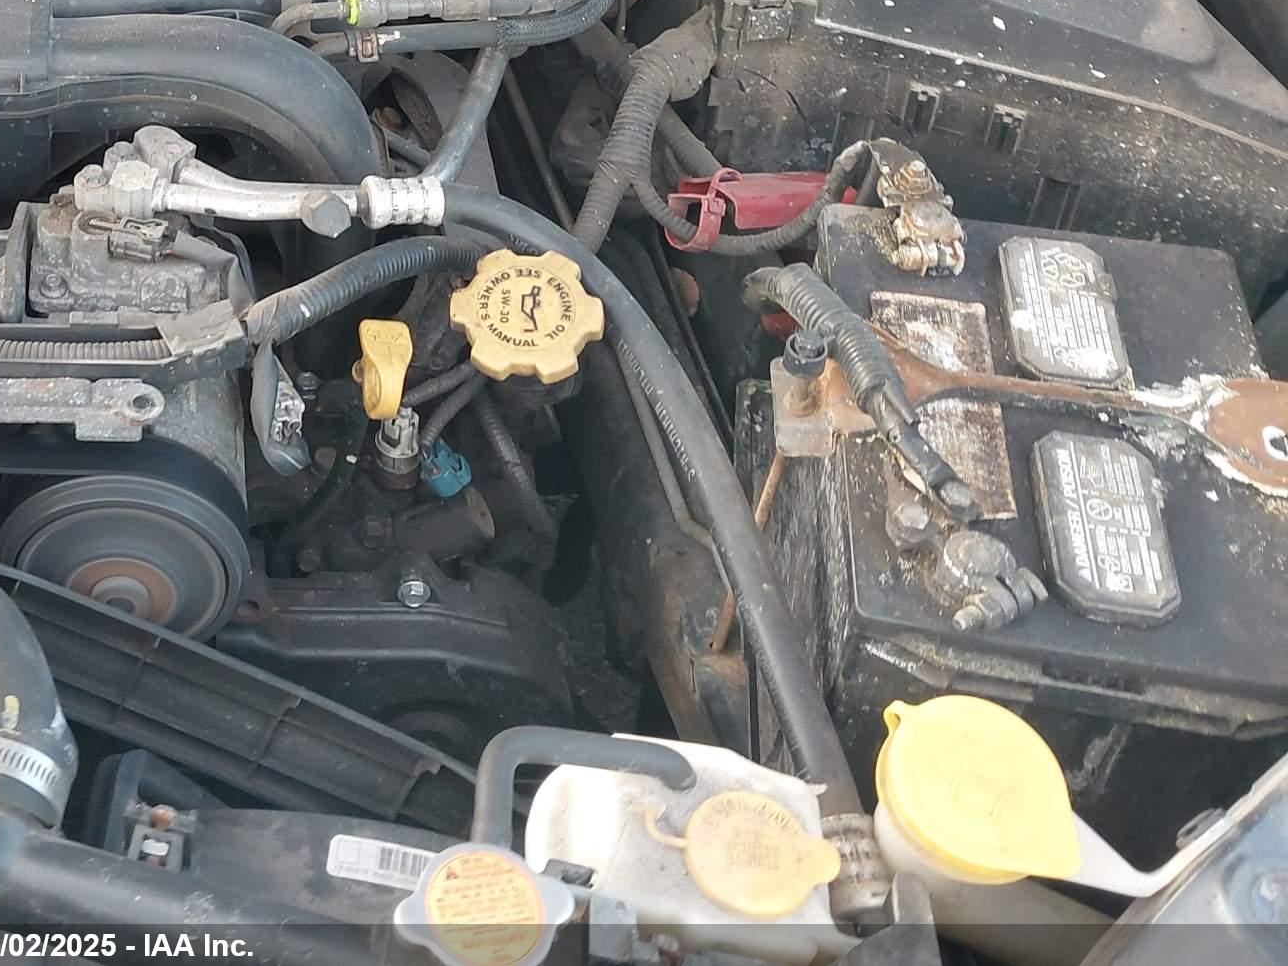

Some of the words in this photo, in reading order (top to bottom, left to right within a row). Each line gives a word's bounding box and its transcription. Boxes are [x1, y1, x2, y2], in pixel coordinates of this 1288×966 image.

[515, 268, 543, 278] SEE
[547, 277, 572, 322] ENGINE
[487, 323, 540, 347] MANUAL
[544, 324, 565, 341] OIL
[1056, 448, 1078, 499] POISON
[1068, 509, 1091, 570] DANGER
